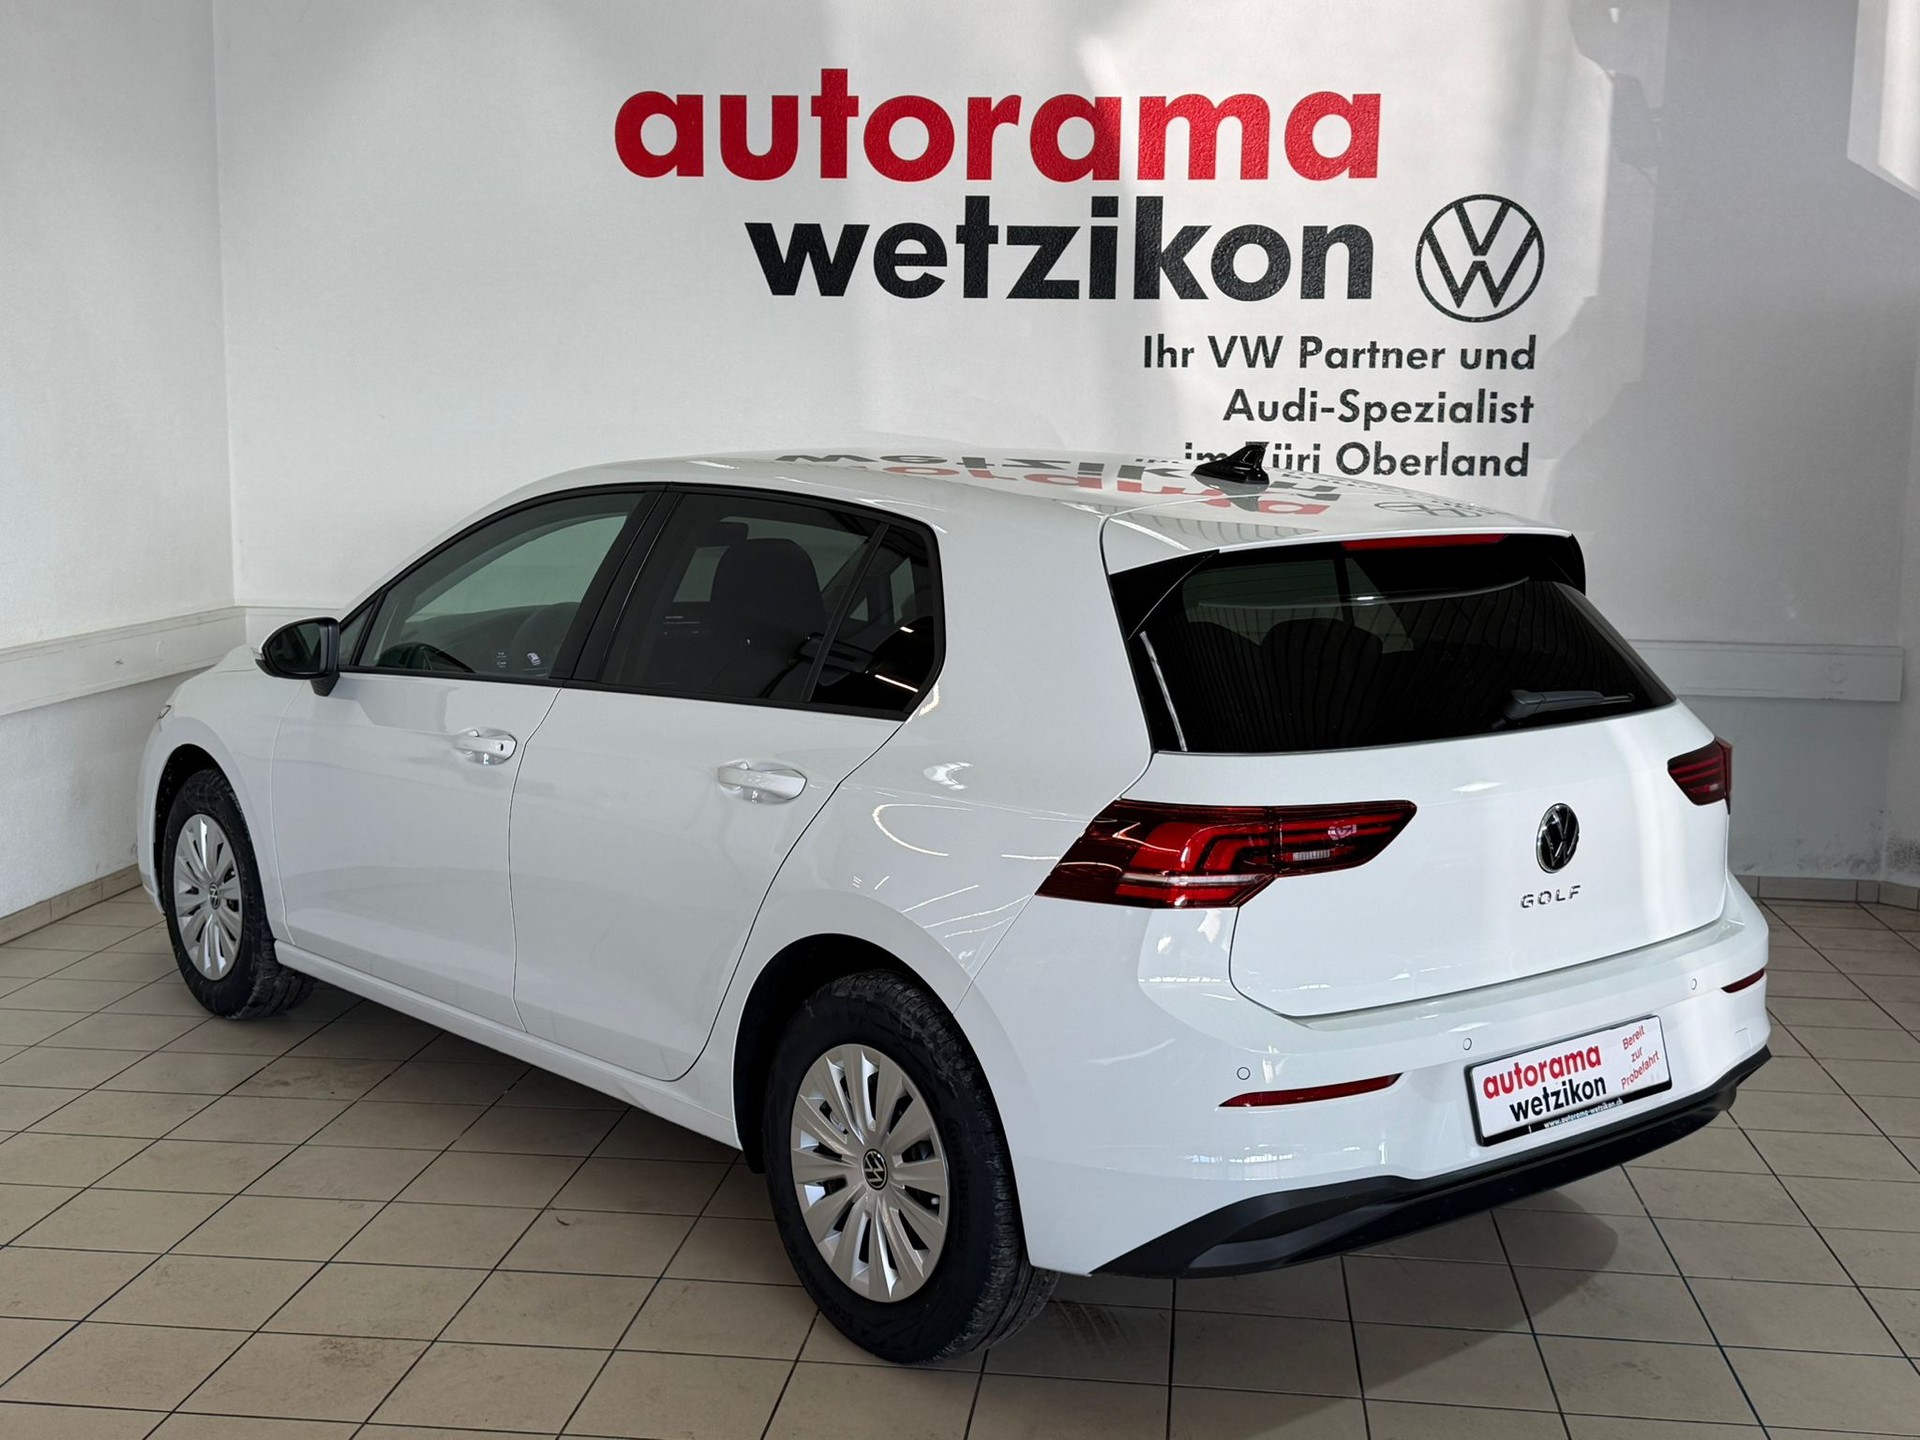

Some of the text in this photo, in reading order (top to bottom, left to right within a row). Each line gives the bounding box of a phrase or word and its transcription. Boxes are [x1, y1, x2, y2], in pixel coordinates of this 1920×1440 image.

[615, 68, 1381, 182] autorama
[745, 194, 1374, 301] wetzikon
[1144, 333, 1536, 370] Ihr VW Partner und
[1222, 388, 1535, 430] Audi-Spezialist
[1244, 441, 1321, 474] üri
[1336, 441, 1530, 477] Oberland
[1520, 884, 1582, 909] GOLF
[1622, 1025, 1646, 1050] Bereit
[1631, 1046, 1644, 1063] zur
[1483, 1045, 1602, 1099] autorama
[1621, 1050, 1660, 1090] Probefahrt
[1509, 1075, 1607, 1122] wetzikon
